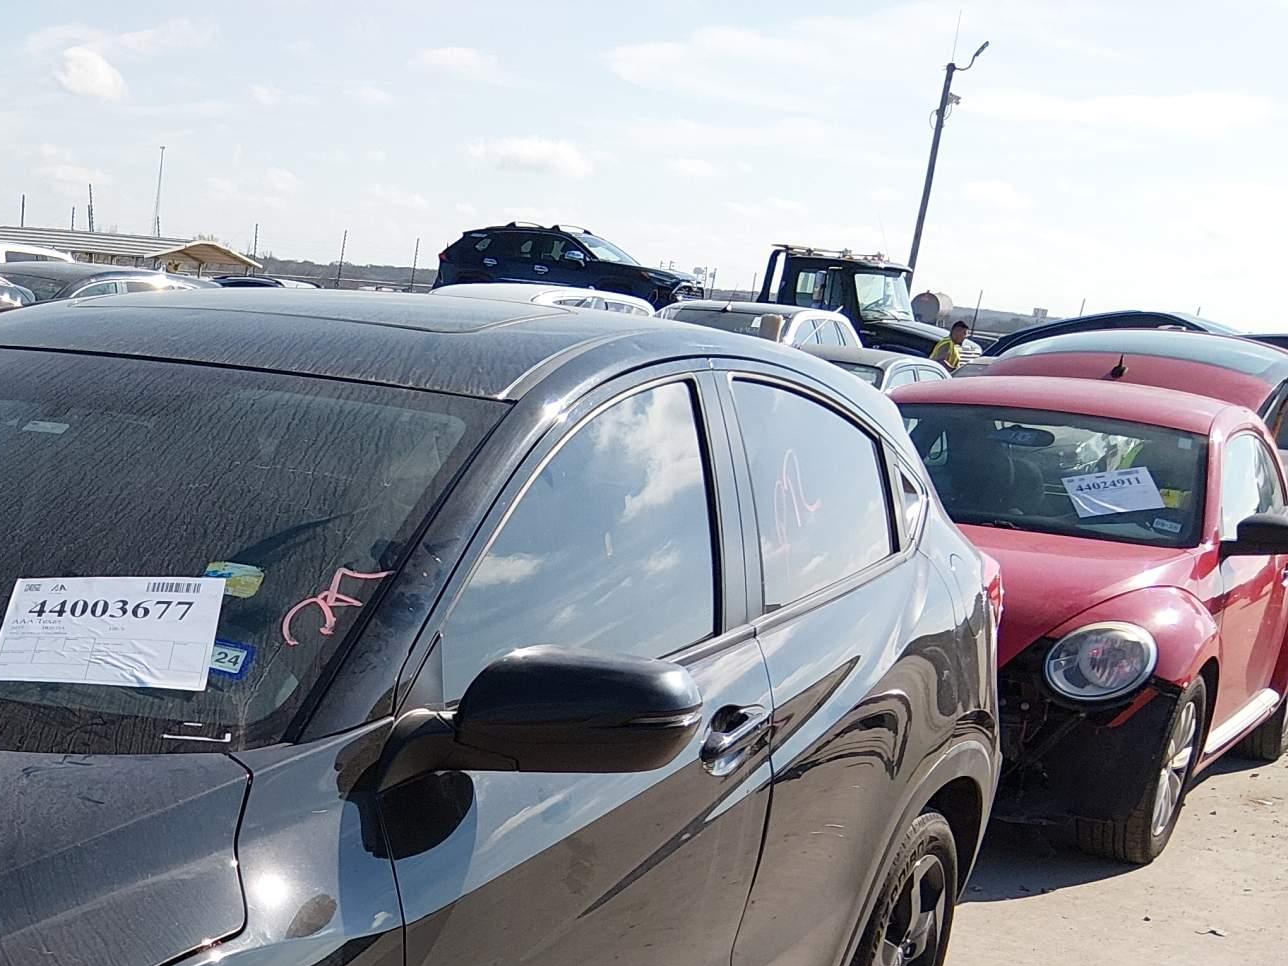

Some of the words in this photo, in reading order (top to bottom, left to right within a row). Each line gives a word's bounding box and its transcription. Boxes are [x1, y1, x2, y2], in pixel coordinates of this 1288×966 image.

[1076, 476, 1141, 491] 44024911
[28, 599, 195, 621] 44003677
[214, 651, 240, 667] 24
